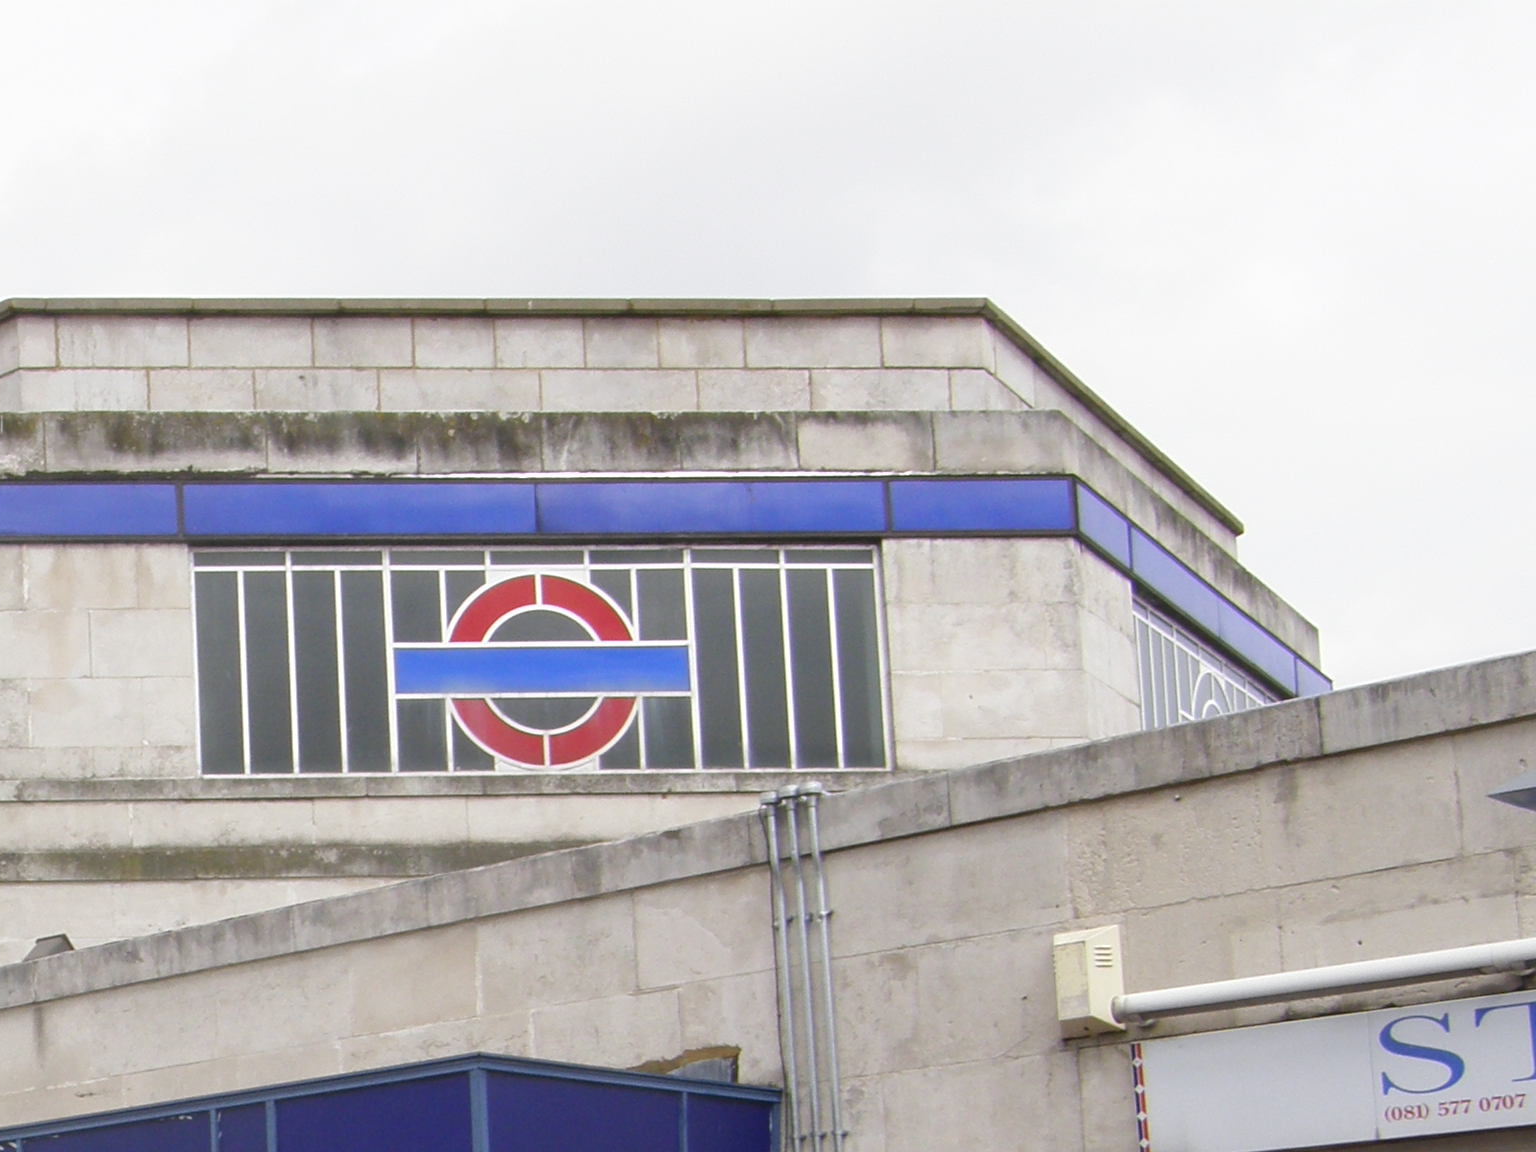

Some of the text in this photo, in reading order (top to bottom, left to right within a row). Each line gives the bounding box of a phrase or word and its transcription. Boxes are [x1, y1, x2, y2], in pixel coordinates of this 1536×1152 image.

[1384, 1093, 1527, 1123] (081) 577 0707
